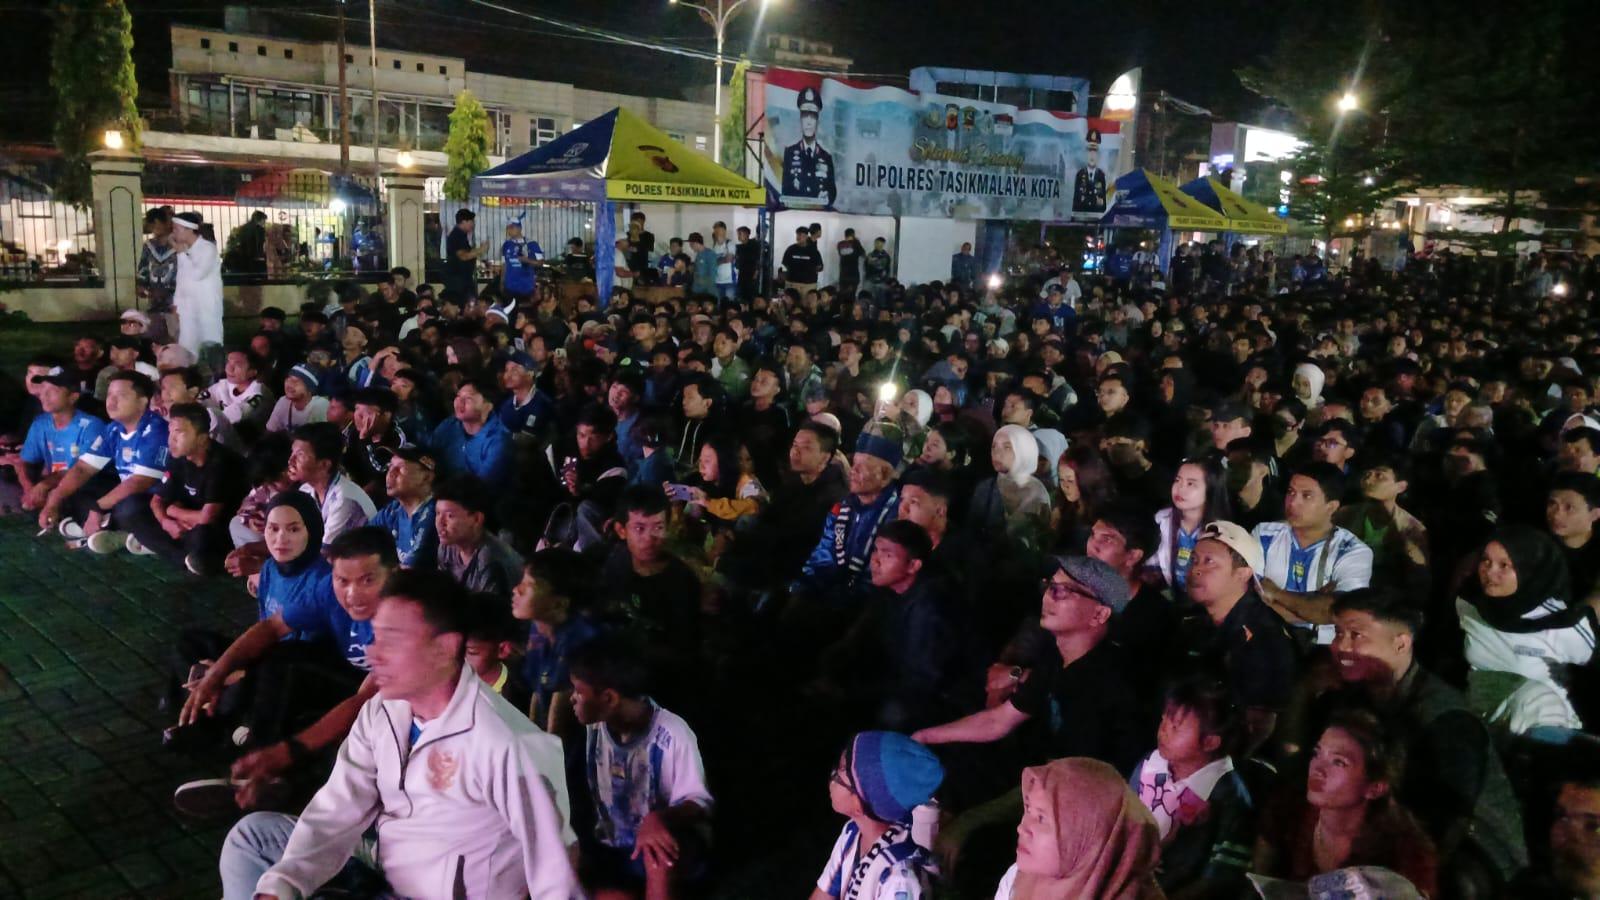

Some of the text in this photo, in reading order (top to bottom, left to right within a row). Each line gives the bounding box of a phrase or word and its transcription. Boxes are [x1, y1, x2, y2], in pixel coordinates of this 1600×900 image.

[625, 183, 751, 199] POLRES TASIKMALAYA KOTA
[856, 163, 1061, 199] DI POLRES TASIKMALAYA KOTA
